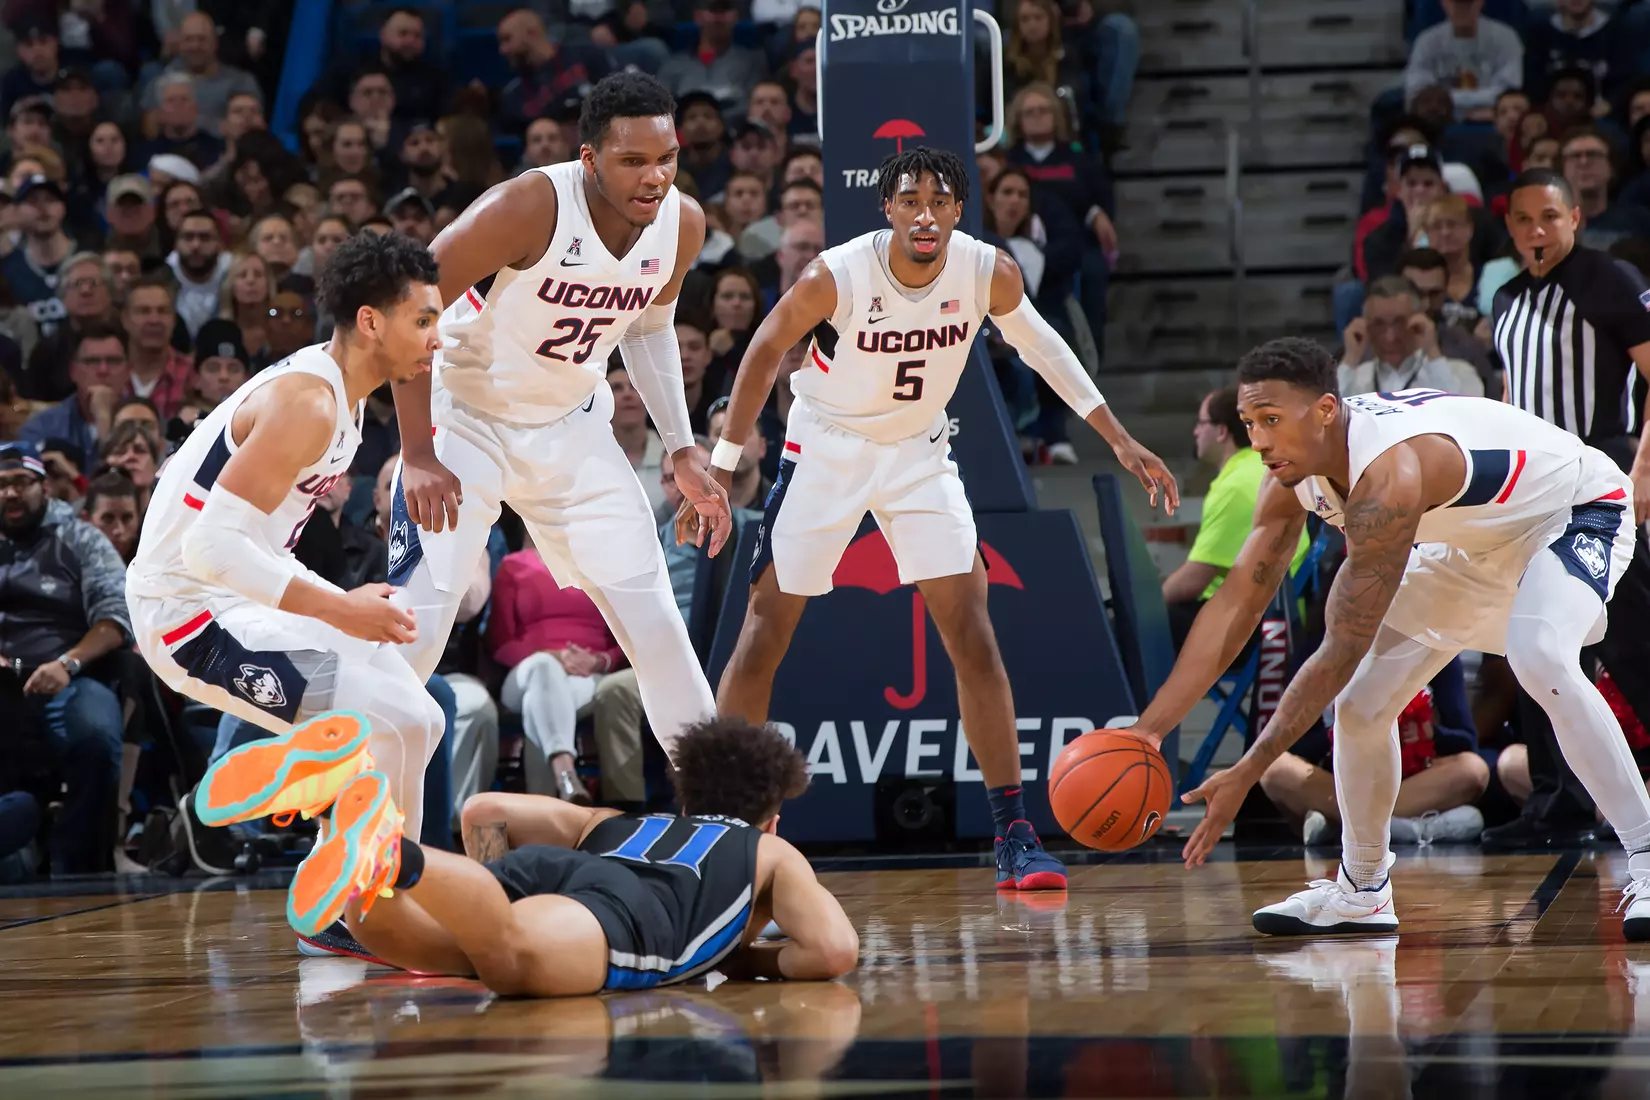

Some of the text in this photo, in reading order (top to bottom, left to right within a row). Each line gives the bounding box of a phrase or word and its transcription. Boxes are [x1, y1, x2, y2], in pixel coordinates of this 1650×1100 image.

[830, 7, 957, 42] SPALDING
[536, 277, 654, 311] UCONN
[535, 317, 617, 365] 25
[856, 321, 969, 353] UCONN
[892, 359, 926, 401] 5
[1092, 810, 1122, 840] UCONN
[600, 816, 731, 880] 11
